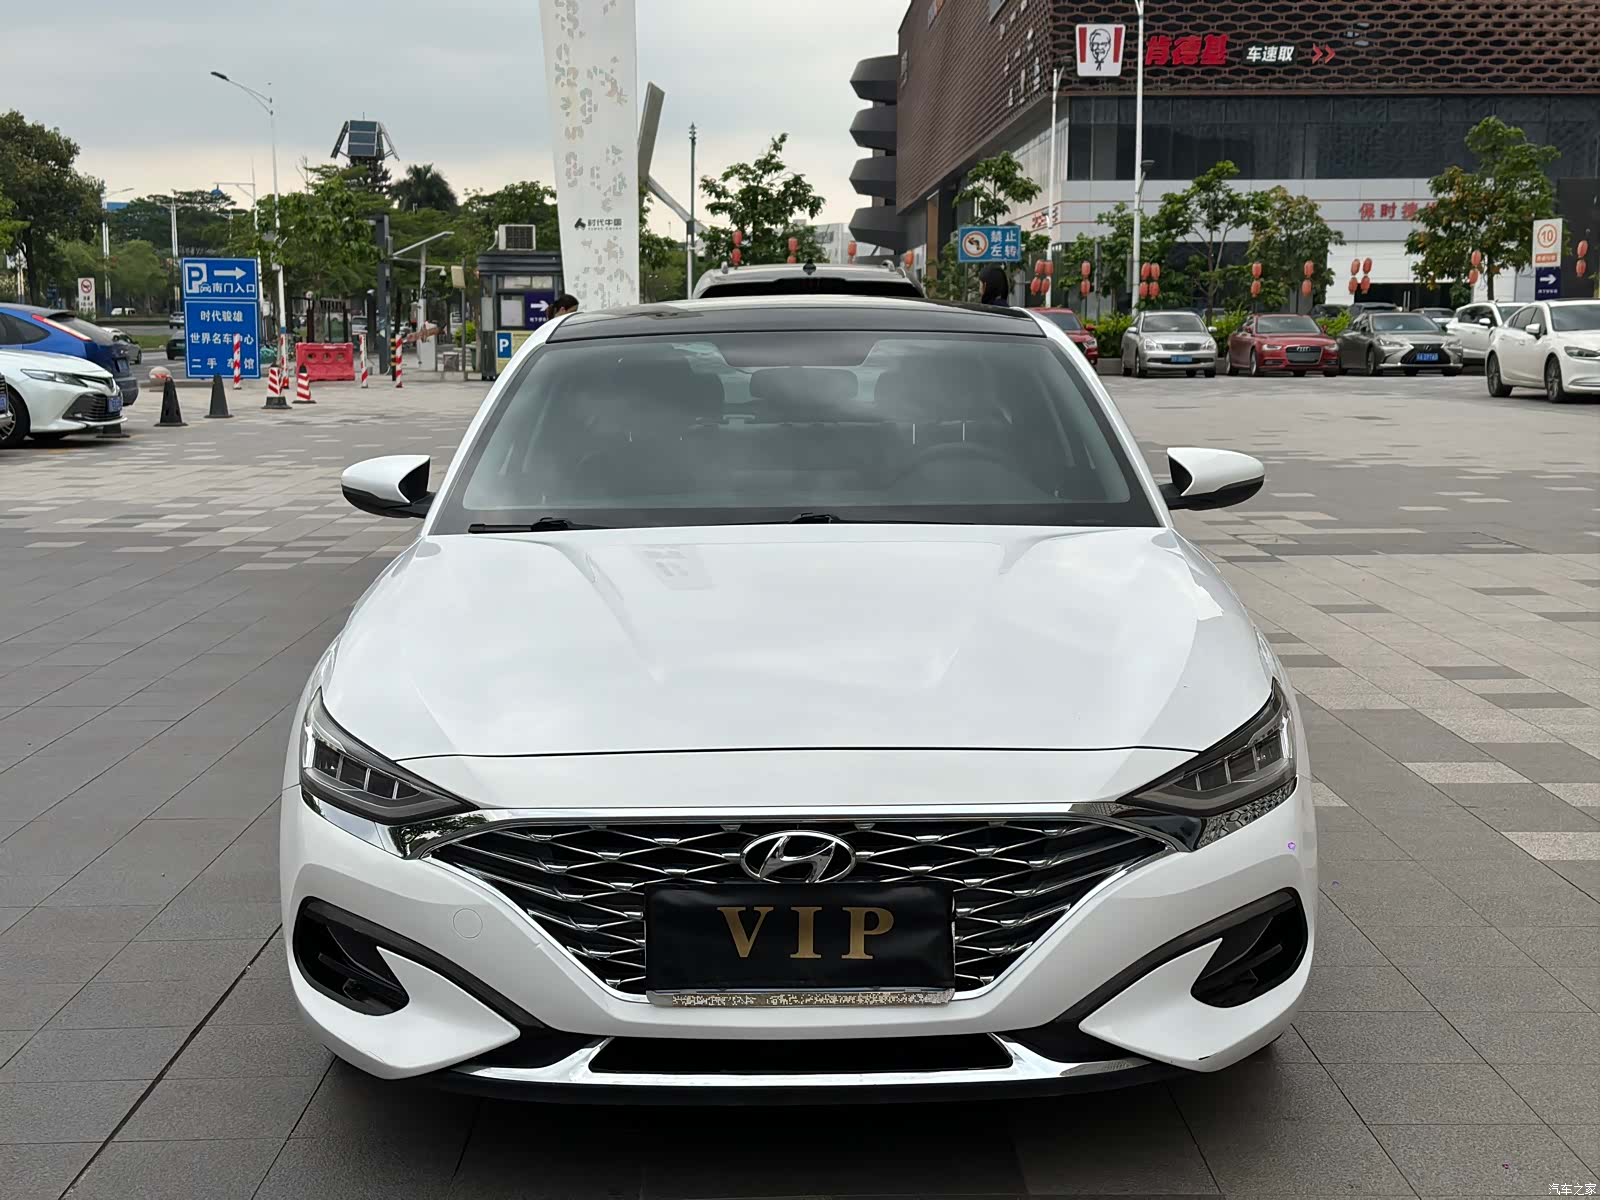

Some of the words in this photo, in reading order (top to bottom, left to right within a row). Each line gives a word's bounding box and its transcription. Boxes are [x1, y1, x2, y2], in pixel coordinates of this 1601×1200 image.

[1145, 34, 1229, 65] 肯德基
[1246, 45, 1295, 62] 车速取
[587, 218, 622, 226] 时代中国
[990, 230, 1017, 242] 禁止
[1541, 230, 1554, 242] 10
[990, 245, 1017, 257] 左转
[187, 266, 204, 290] P
[212, 282, 255, 293] 南门入口
[190, 332, 254, 345] 世界名车心
[499, 338, 509, 352] P
[717, 906, 895, 960] VIP
